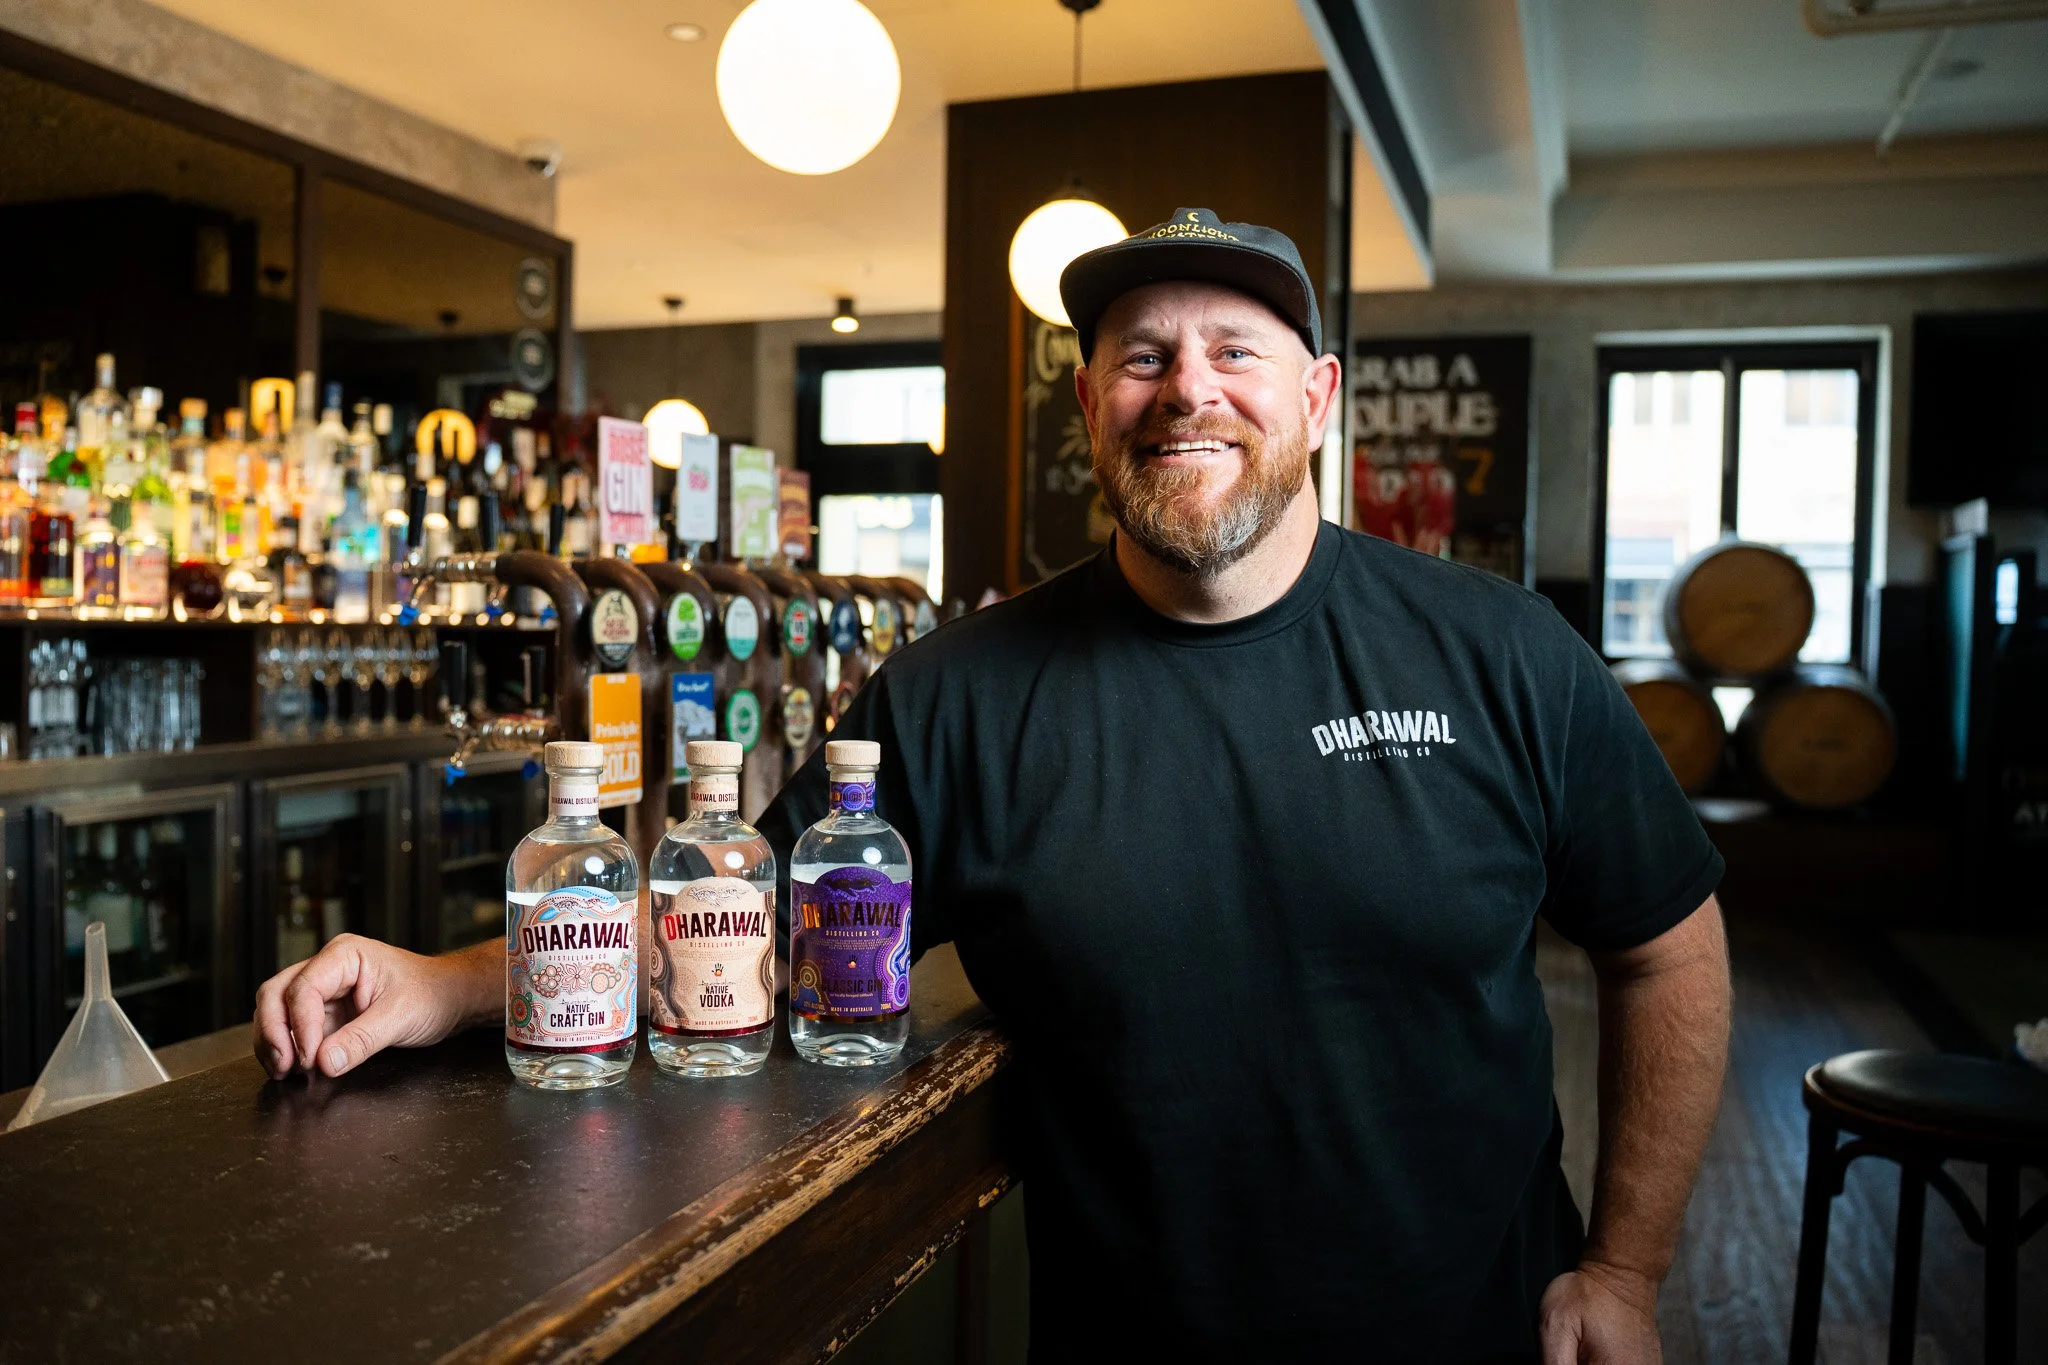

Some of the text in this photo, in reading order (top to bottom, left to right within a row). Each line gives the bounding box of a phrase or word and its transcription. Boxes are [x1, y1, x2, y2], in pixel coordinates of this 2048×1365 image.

[1447, 353, 1480, 387] A
[1354, 391, 1499, 439] OUPLE
[606, 461, 647, 515] GIN
[1311, 710, 1457, 757] DHARAWAL
[1343, 746, 1430, 762] DISTILLING CO
[802, 901, 901, 929] DHARAWAL
[664, 911, 767, 941] DHARAWAL
[825, 929, 880, 937] DISTILLING CO
[522, 922, 630, 955] DHARAWAL
[689, 941, 733, 949] DISTILLING
[598, 952, 607, 960] CO
[705, 985, 729, 995] NATIVE
[566, 1003, 591, 1014] NATIVE
[699, 994, 734, 1008] VODKA
[550, 1011, 605, 1028] CRAFT GIN
